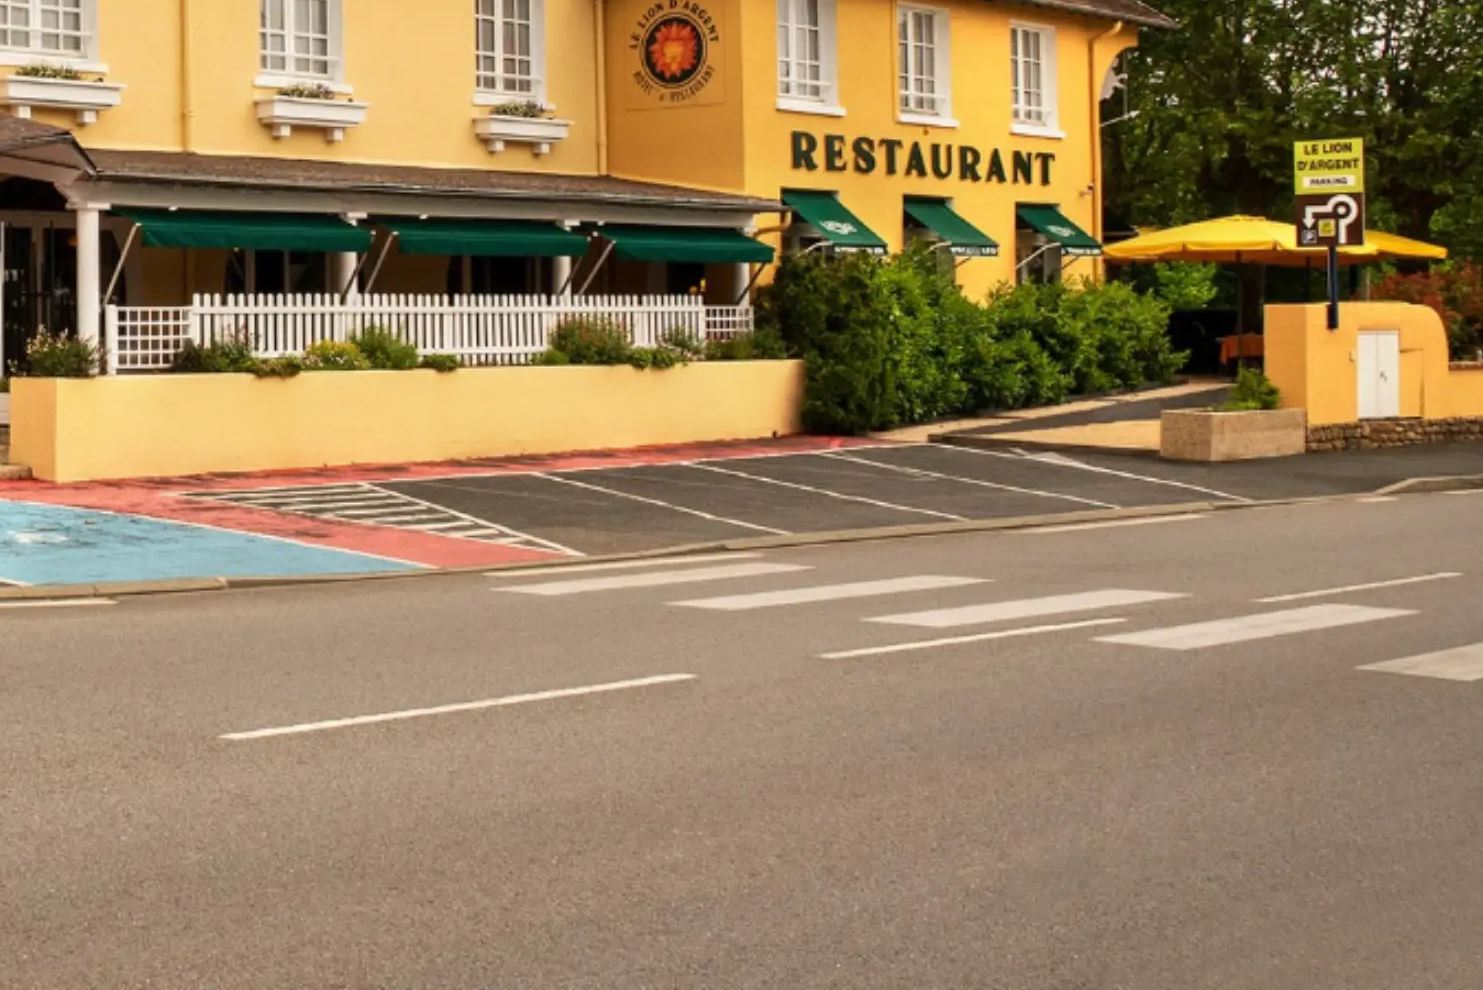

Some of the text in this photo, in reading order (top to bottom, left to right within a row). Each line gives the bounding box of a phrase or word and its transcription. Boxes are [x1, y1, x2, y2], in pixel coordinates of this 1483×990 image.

[637, 3, 664, 29] LION
[791, 130, 1056, 186] RESTAURANT
[1303, 142, 1352, 156] LE LION
[1298, 158, 1359, 171] D'ARGENT
